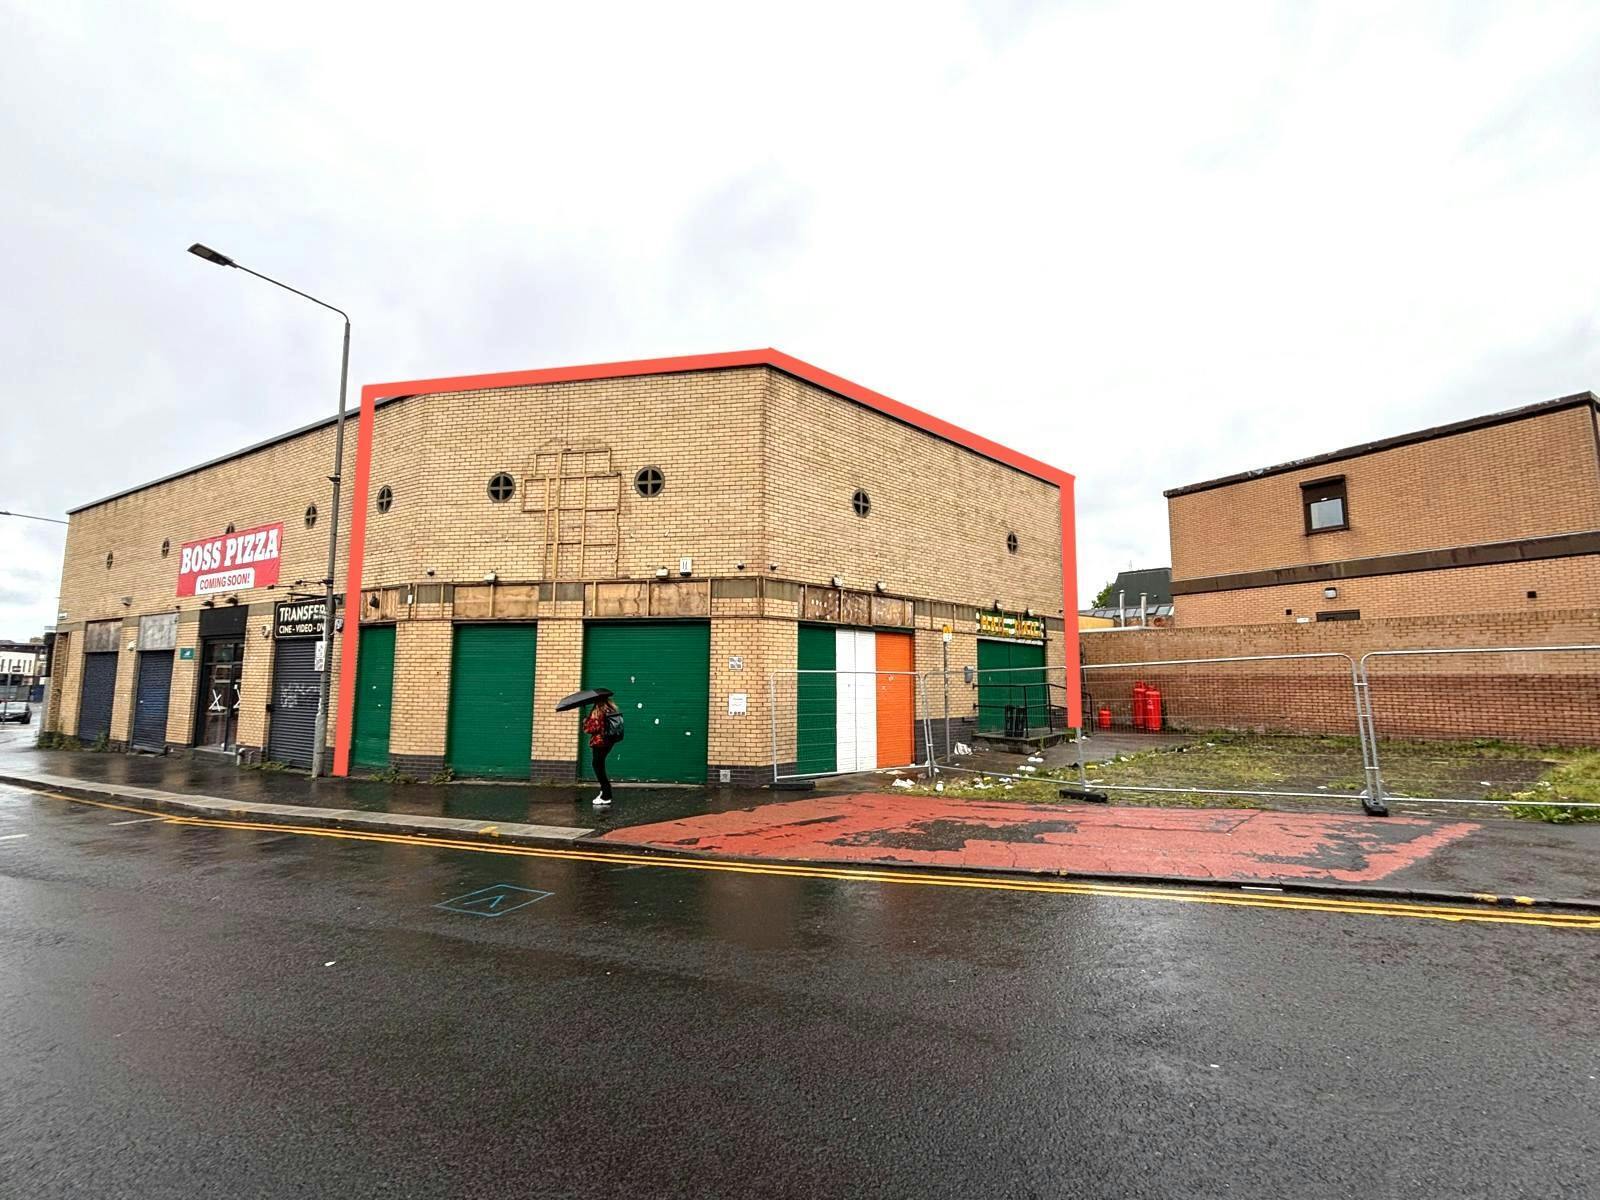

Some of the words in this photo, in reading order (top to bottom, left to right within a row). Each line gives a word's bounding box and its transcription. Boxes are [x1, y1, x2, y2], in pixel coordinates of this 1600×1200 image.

[180, 540, 223, 575] BOSS
[223, 528, 279, 567] PIZZA
[199, 576, 226, 591] COMING
[227, 573, 251, 586] SOON!
[278, 624, 292, 634] CINE
[295, 623, 313, 633] VIDEO
[316, 622, 325, 632] DV
